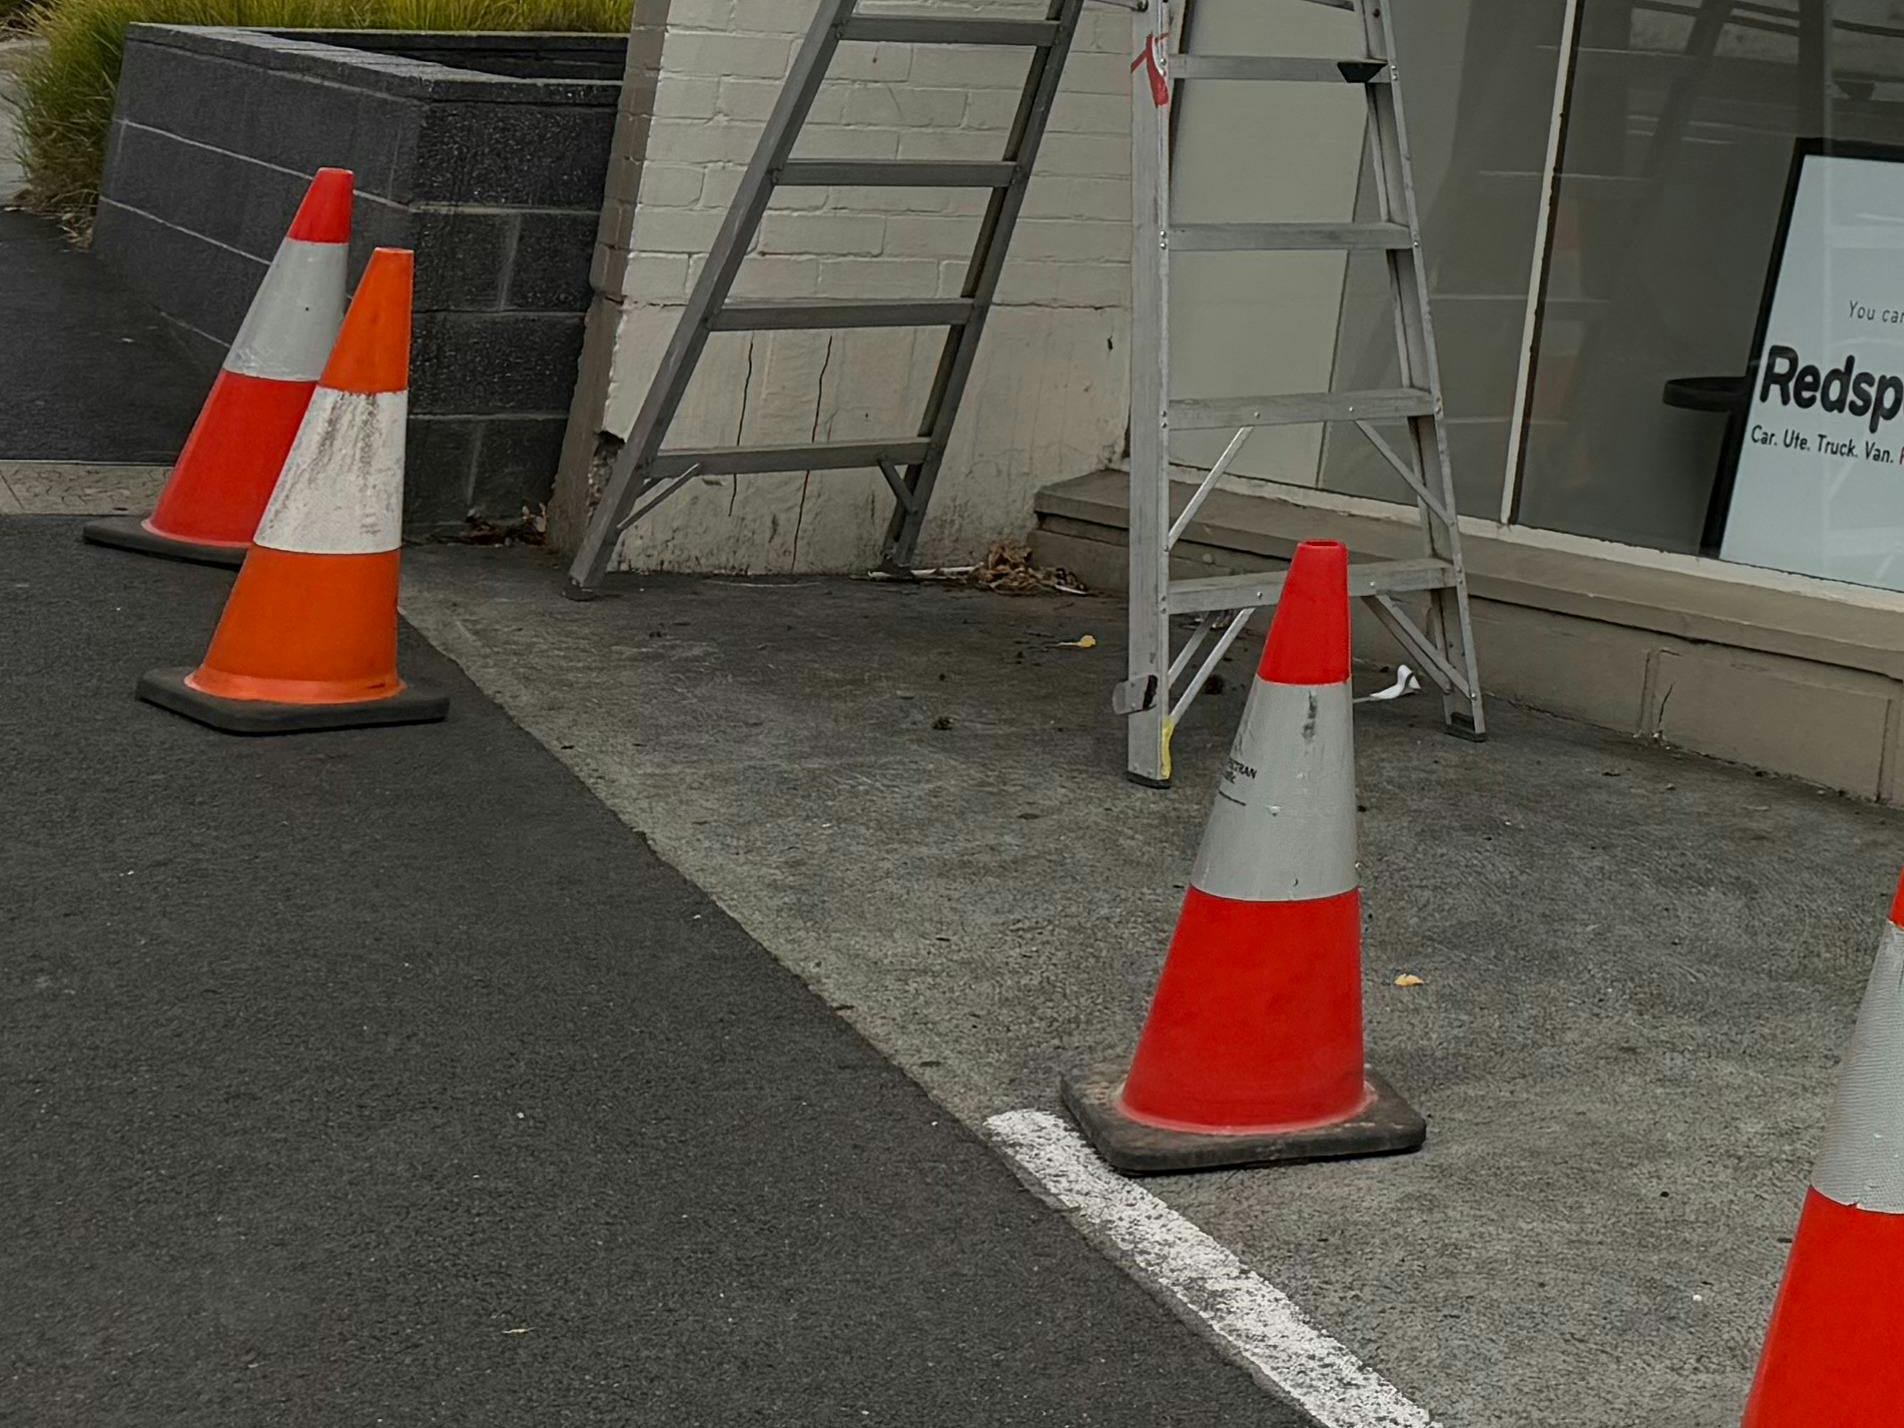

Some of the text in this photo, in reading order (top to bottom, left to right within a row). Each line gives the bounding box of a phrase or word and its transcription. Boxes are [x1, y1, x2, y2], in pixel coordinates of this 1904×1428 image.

[1849, 301, 1876, 320] You
[1751, 424, 1777, 446] Car.
[1783, 429, 1811, 451] Ute.
[1817, 434, 1858, 458] Truck.
[1865, 441, 1894, 464] Van.
